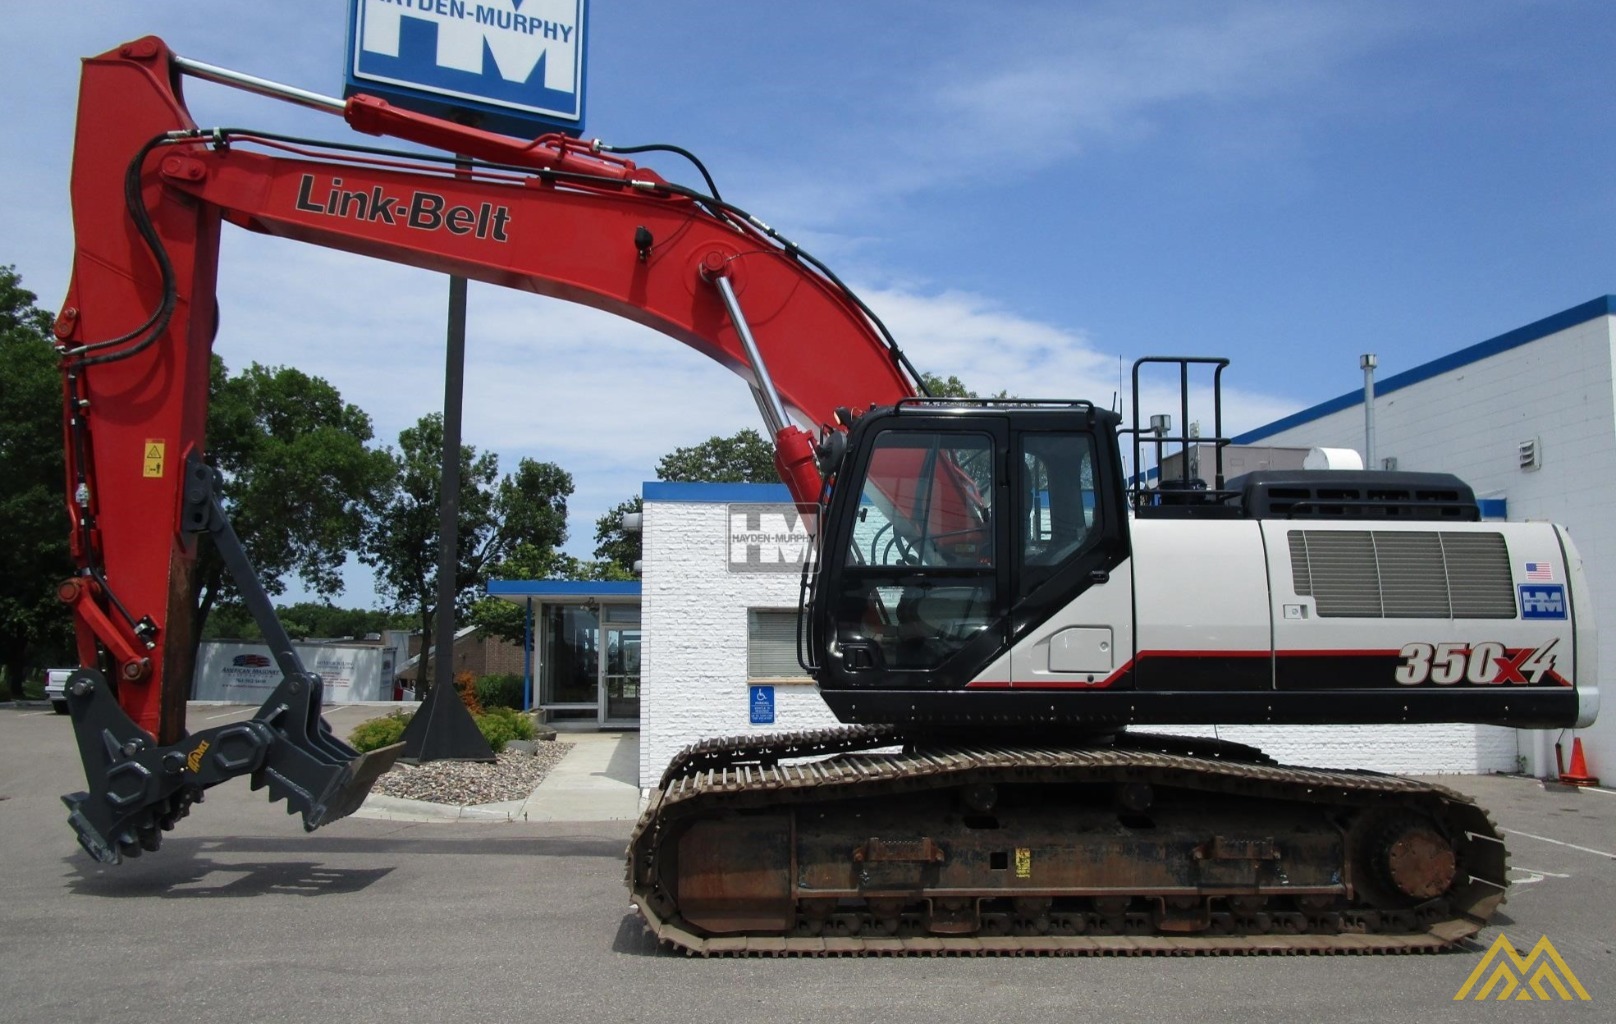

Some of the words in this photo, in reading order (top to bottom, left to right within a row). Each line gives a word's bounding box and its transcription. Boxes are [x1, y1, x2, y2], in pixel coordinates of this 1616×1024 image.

[379, 0, 574, 43] DEN-MURPHY
[295, 173, 511, 242] Link-Belt
[1522, 591, 1563, 612] HM
